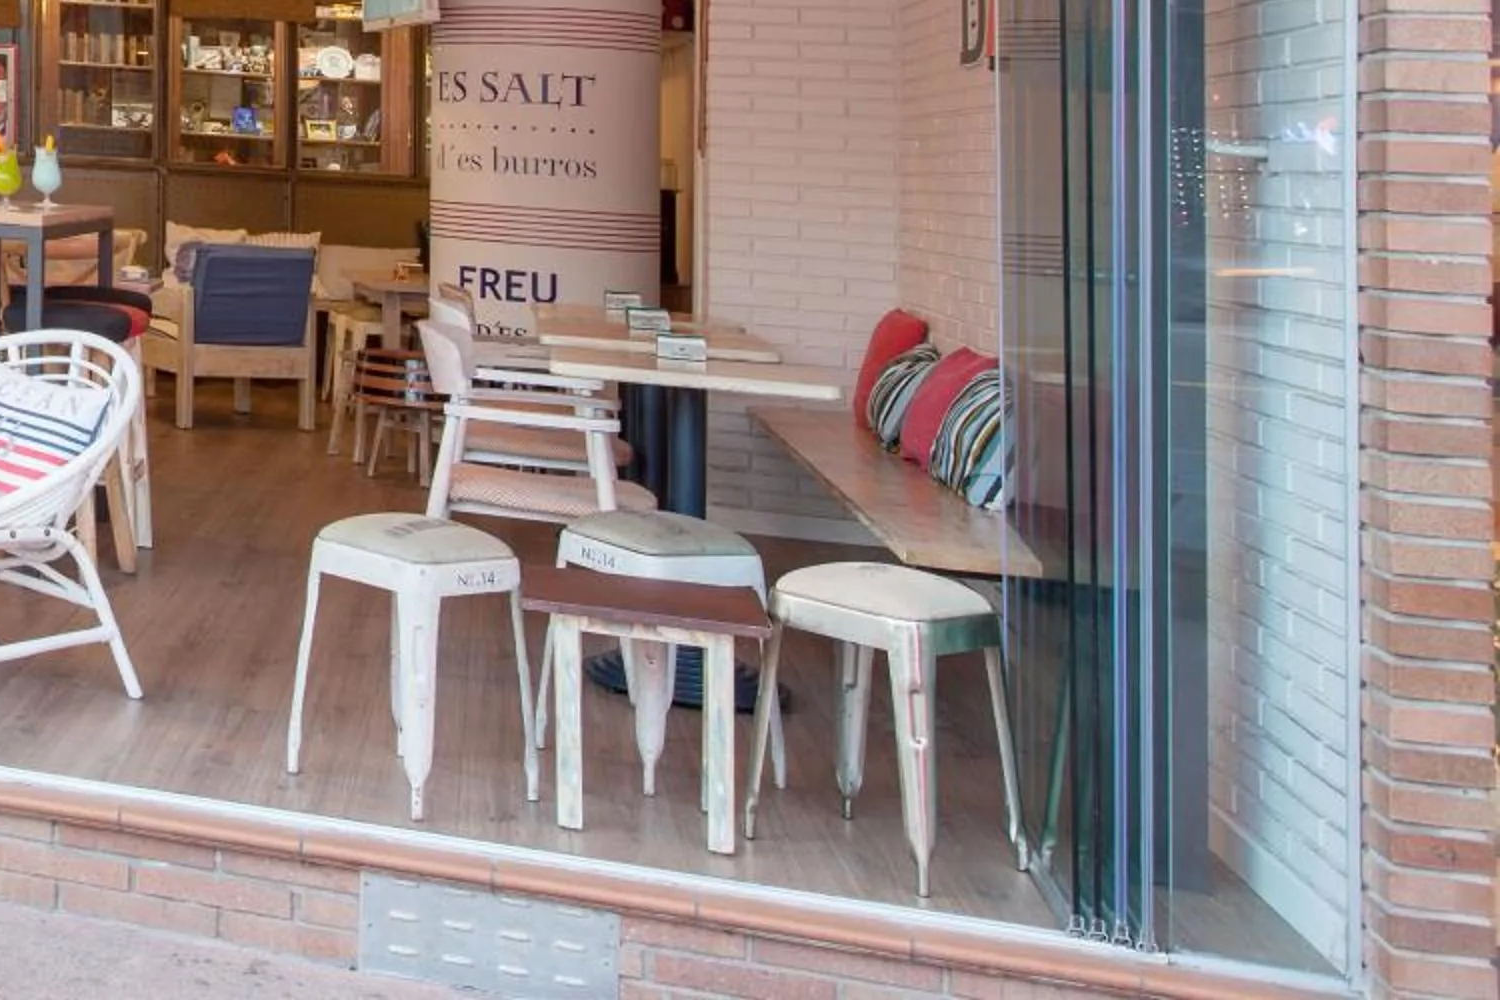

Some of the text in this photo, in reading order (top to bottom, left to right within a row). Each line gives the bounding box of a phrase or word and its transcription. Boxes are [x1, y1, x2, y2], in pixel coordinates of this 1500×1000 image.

[439, 71, 596, 110] ES SALT
[493, 146, 597, 179] burros
[459, 265, 557, 304] FREU
